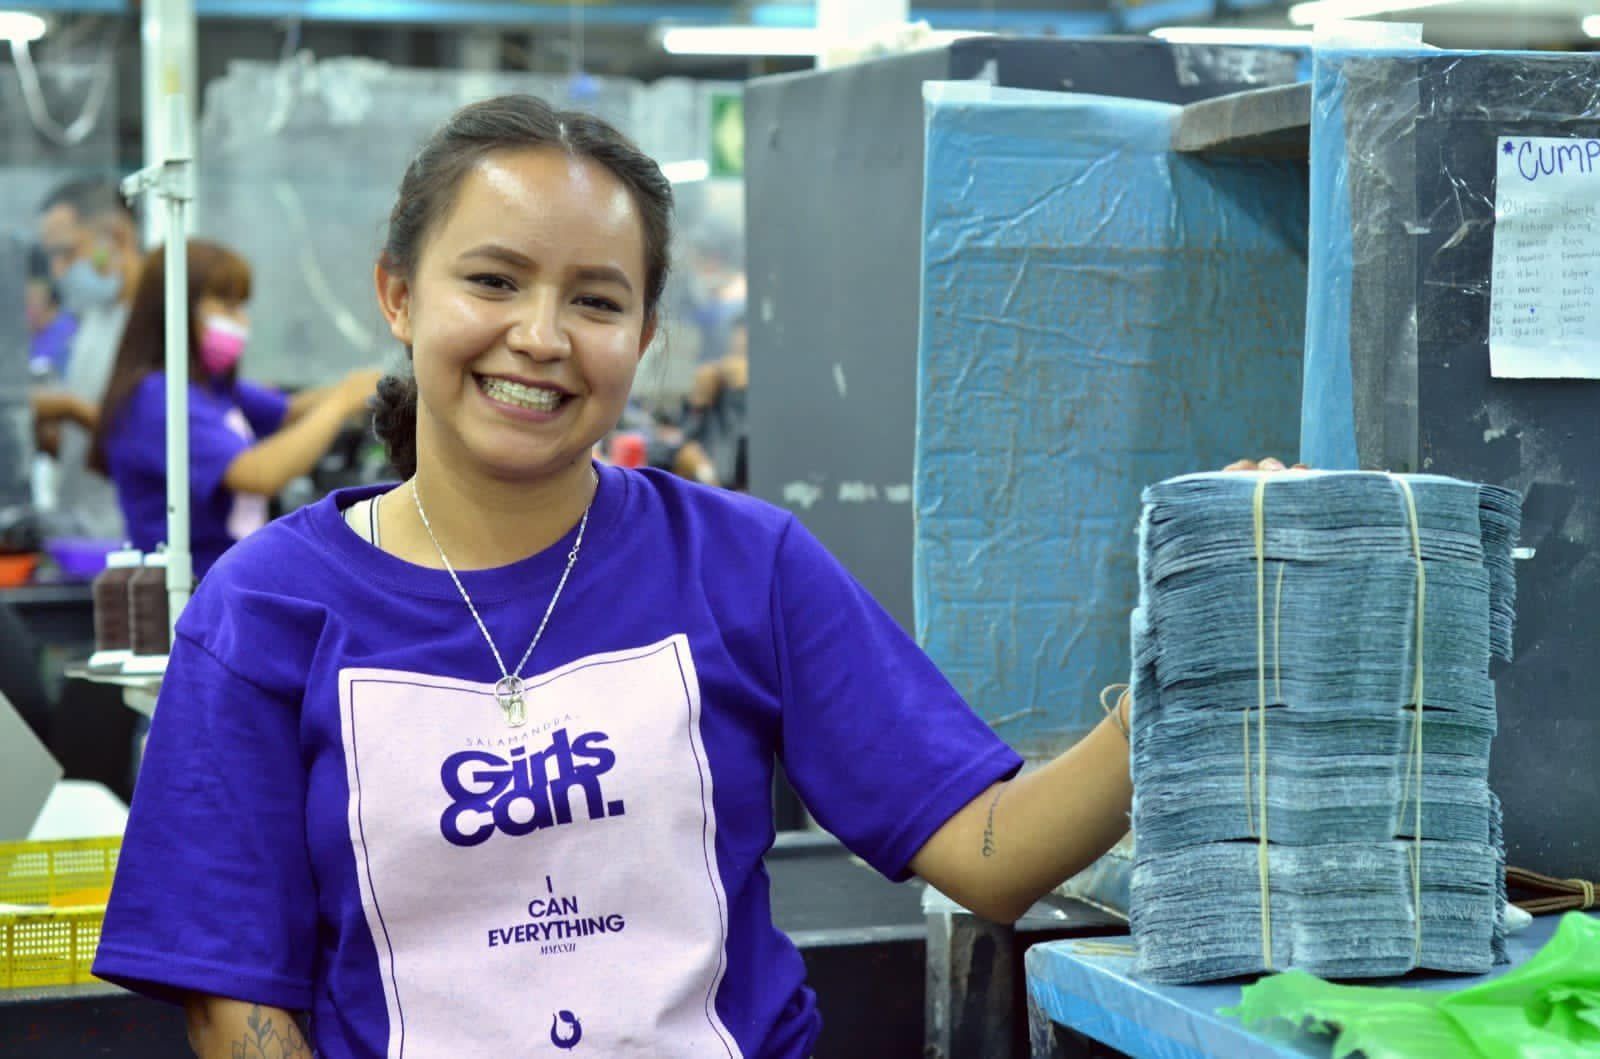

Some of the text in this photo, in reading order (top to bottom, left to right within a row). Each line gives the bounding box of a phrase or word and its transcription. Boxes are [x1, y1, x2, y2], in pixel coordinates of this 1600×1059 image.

[441, 727, 616, 800] Girls
[440, 764, 625, 847] can.
[545, 875, 553, 893] I
[528, 896, 578, 918] CAN
[488, 914, 625, 947] EVERYTHING
[540, 943, 576, 955] MMXXII
